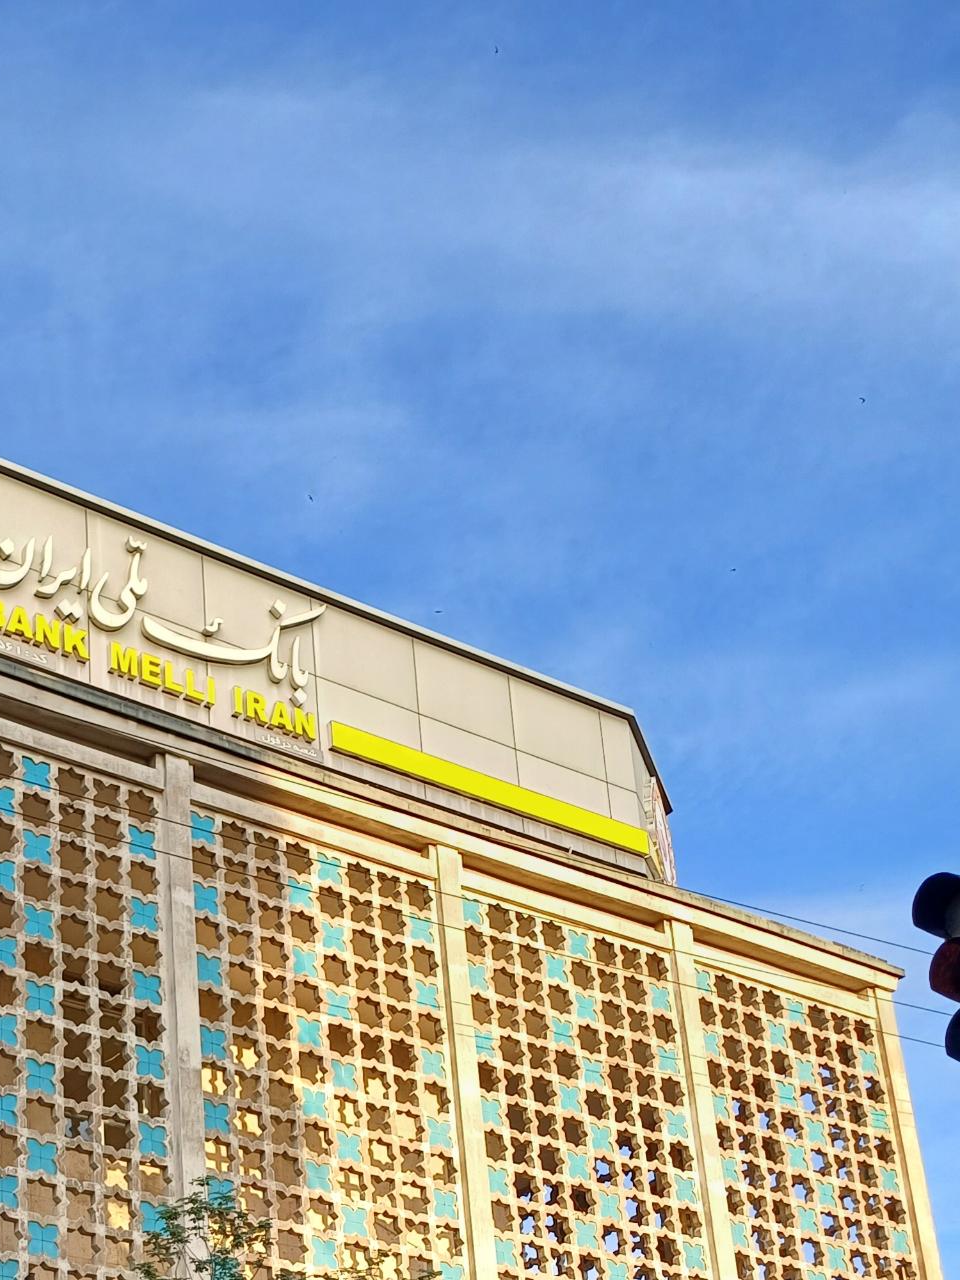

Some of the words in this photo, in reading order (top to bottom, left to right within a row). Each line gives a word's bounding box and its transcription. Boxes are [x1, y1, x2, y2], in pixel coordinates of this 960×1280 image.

[108, 640, 216, 709] MELLI
[231, 685, 317, 743] IRAN
[141, 599, 328, 708] بانک
